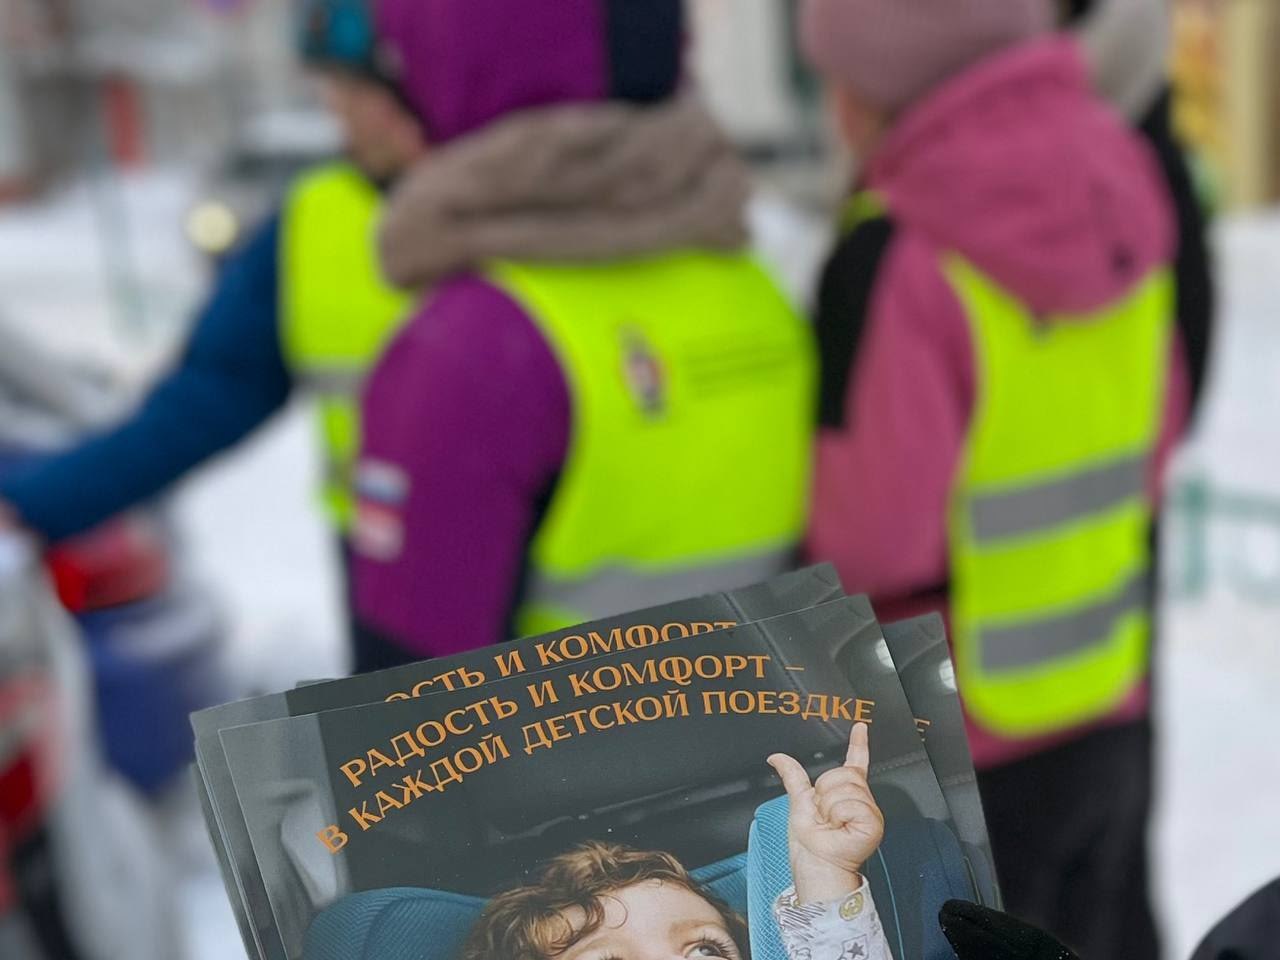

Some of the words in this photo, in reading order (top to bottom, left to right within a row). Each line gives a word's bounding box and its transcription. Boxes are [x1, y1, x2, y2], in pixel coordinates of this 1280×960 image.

[494, 650, 526, 677] И
[536, 621, 736, 666] КОМФО
[316, 824, 348, 854] В
[348, 733, 510, 830] КАЖДОЙ
[521, 689, 690, 755] ДЕТСКОЙ
[702, 690, 875, 723] ПОЕЗДКЕ
[339, 696, 518, 787] РАДОСТЬ
[527, 679, 559, 707] И
[568, 655, 771, 697] КОМФОРТ
